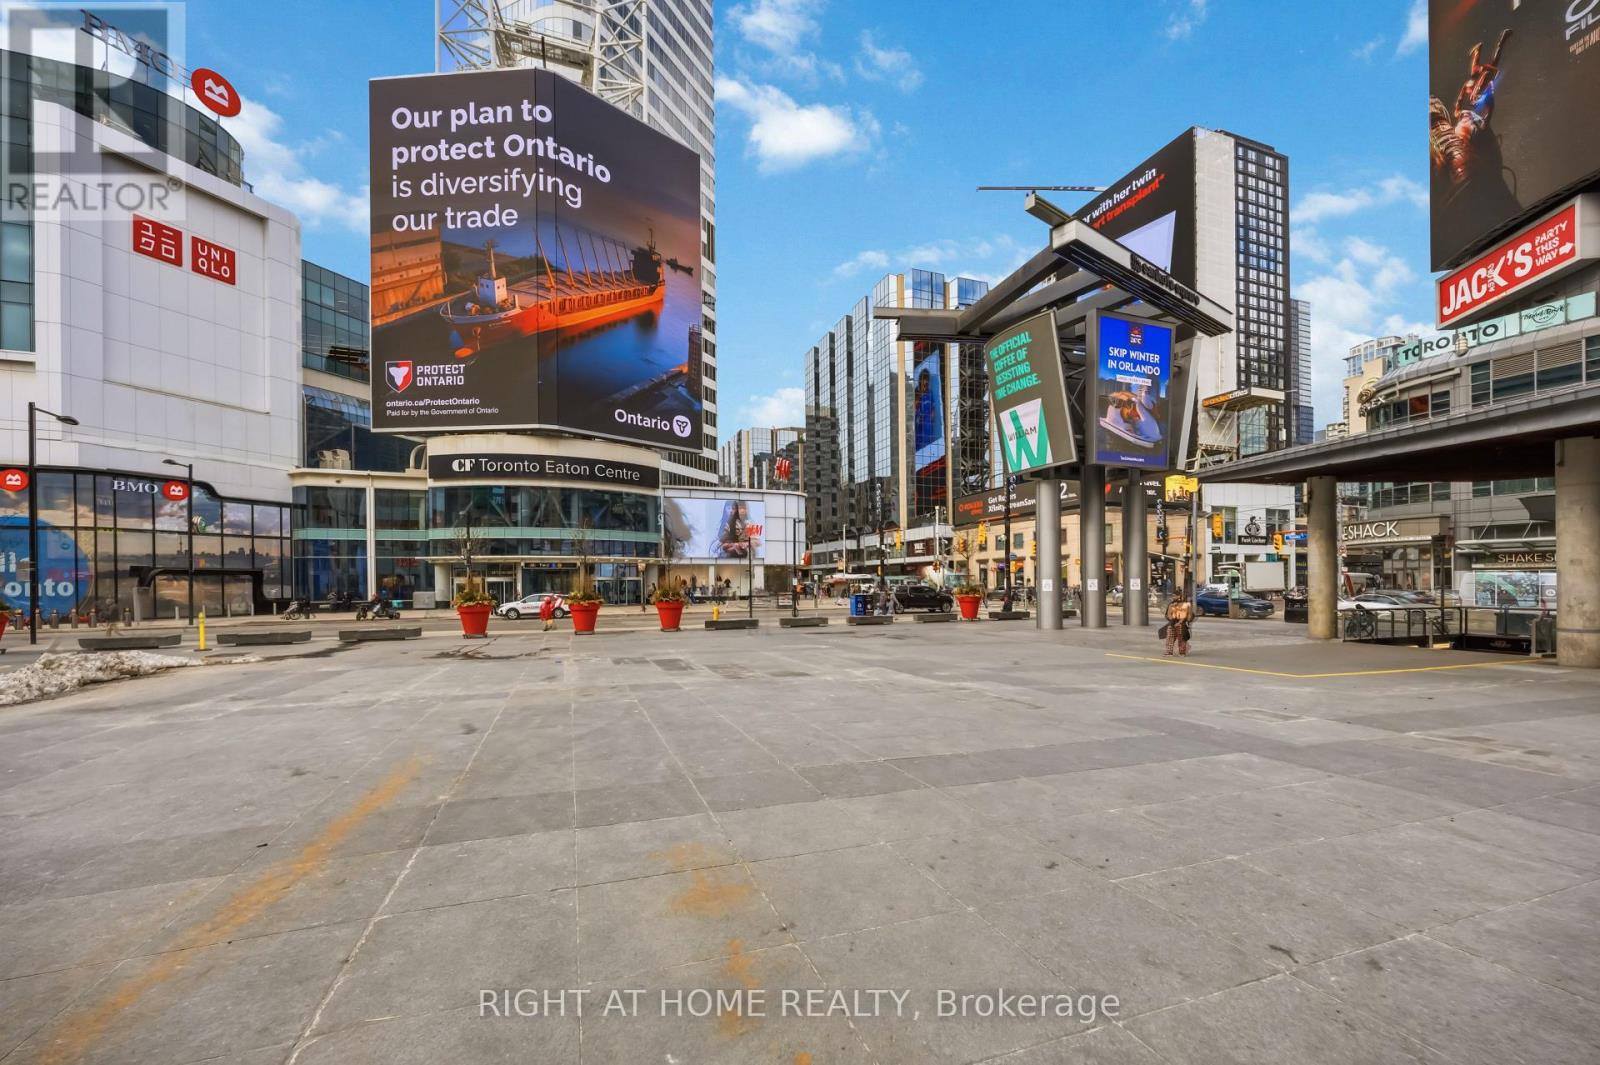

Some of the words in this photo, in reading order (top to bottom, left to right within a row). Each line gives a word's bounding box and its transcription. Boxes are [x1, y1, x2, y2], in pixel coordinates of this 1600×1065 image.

[1565, 12, 1600, 40] FIL
[391, 106, 443, 129] Our
[451, 102, 512, 132] plan
[522, 99, 552, 123] to
[392, 136, 495, 169] protect
[503, 134, 611, 183] Ontario
[392, 174, 411, 197] is
[420, 168, 582, 208] diversifying
[1092, 199, 1112, 219] with
[1113, 185, 1131, 204] her
[1132, 168, 1156, 191] twin
[392, 212, 437, 231] our
[445, 204, 518, 229] trade
[1535, 220, 1568, 246] PARTY
[198, 242, 227, 264] UNI
[1535, 237, 1560, 256] THIS
[198, 257, 230, 278] QLO
[1535, 250, 1558, 267] WAY
[1442, 242, 1533, 316] JACK'S
[998, 331, 1032, 355] OFFICIAL
[1017, 347, 1028, 361] OF
[1109, 347, 1127, 358] SKIP
[1129, 350, 1160, 364] WINTER
[417, 364, 466, 375] PROTECT
[1108, 359, 1117, 369] IN
[1118, 360, 1160, 376] ORLANDO
[417, 375, 464, 387] ONTARIO
[386, 397, 480, 407] ontario.ca/ProtectOntario
[410, 409, 418, 417] by
[476, 406, 499, 414] Ontario
[614, 408, 671, 432] Ontario
[451, 458, 475, 472] CF
[478, 458, 540, 473] Toronto
[545, 460, 589, 476] Eaton
[594, 464, 641, 482] Centre
[113, 480, 159, 494] BMO
[1498, 553, 1542, 563] SHAKE
